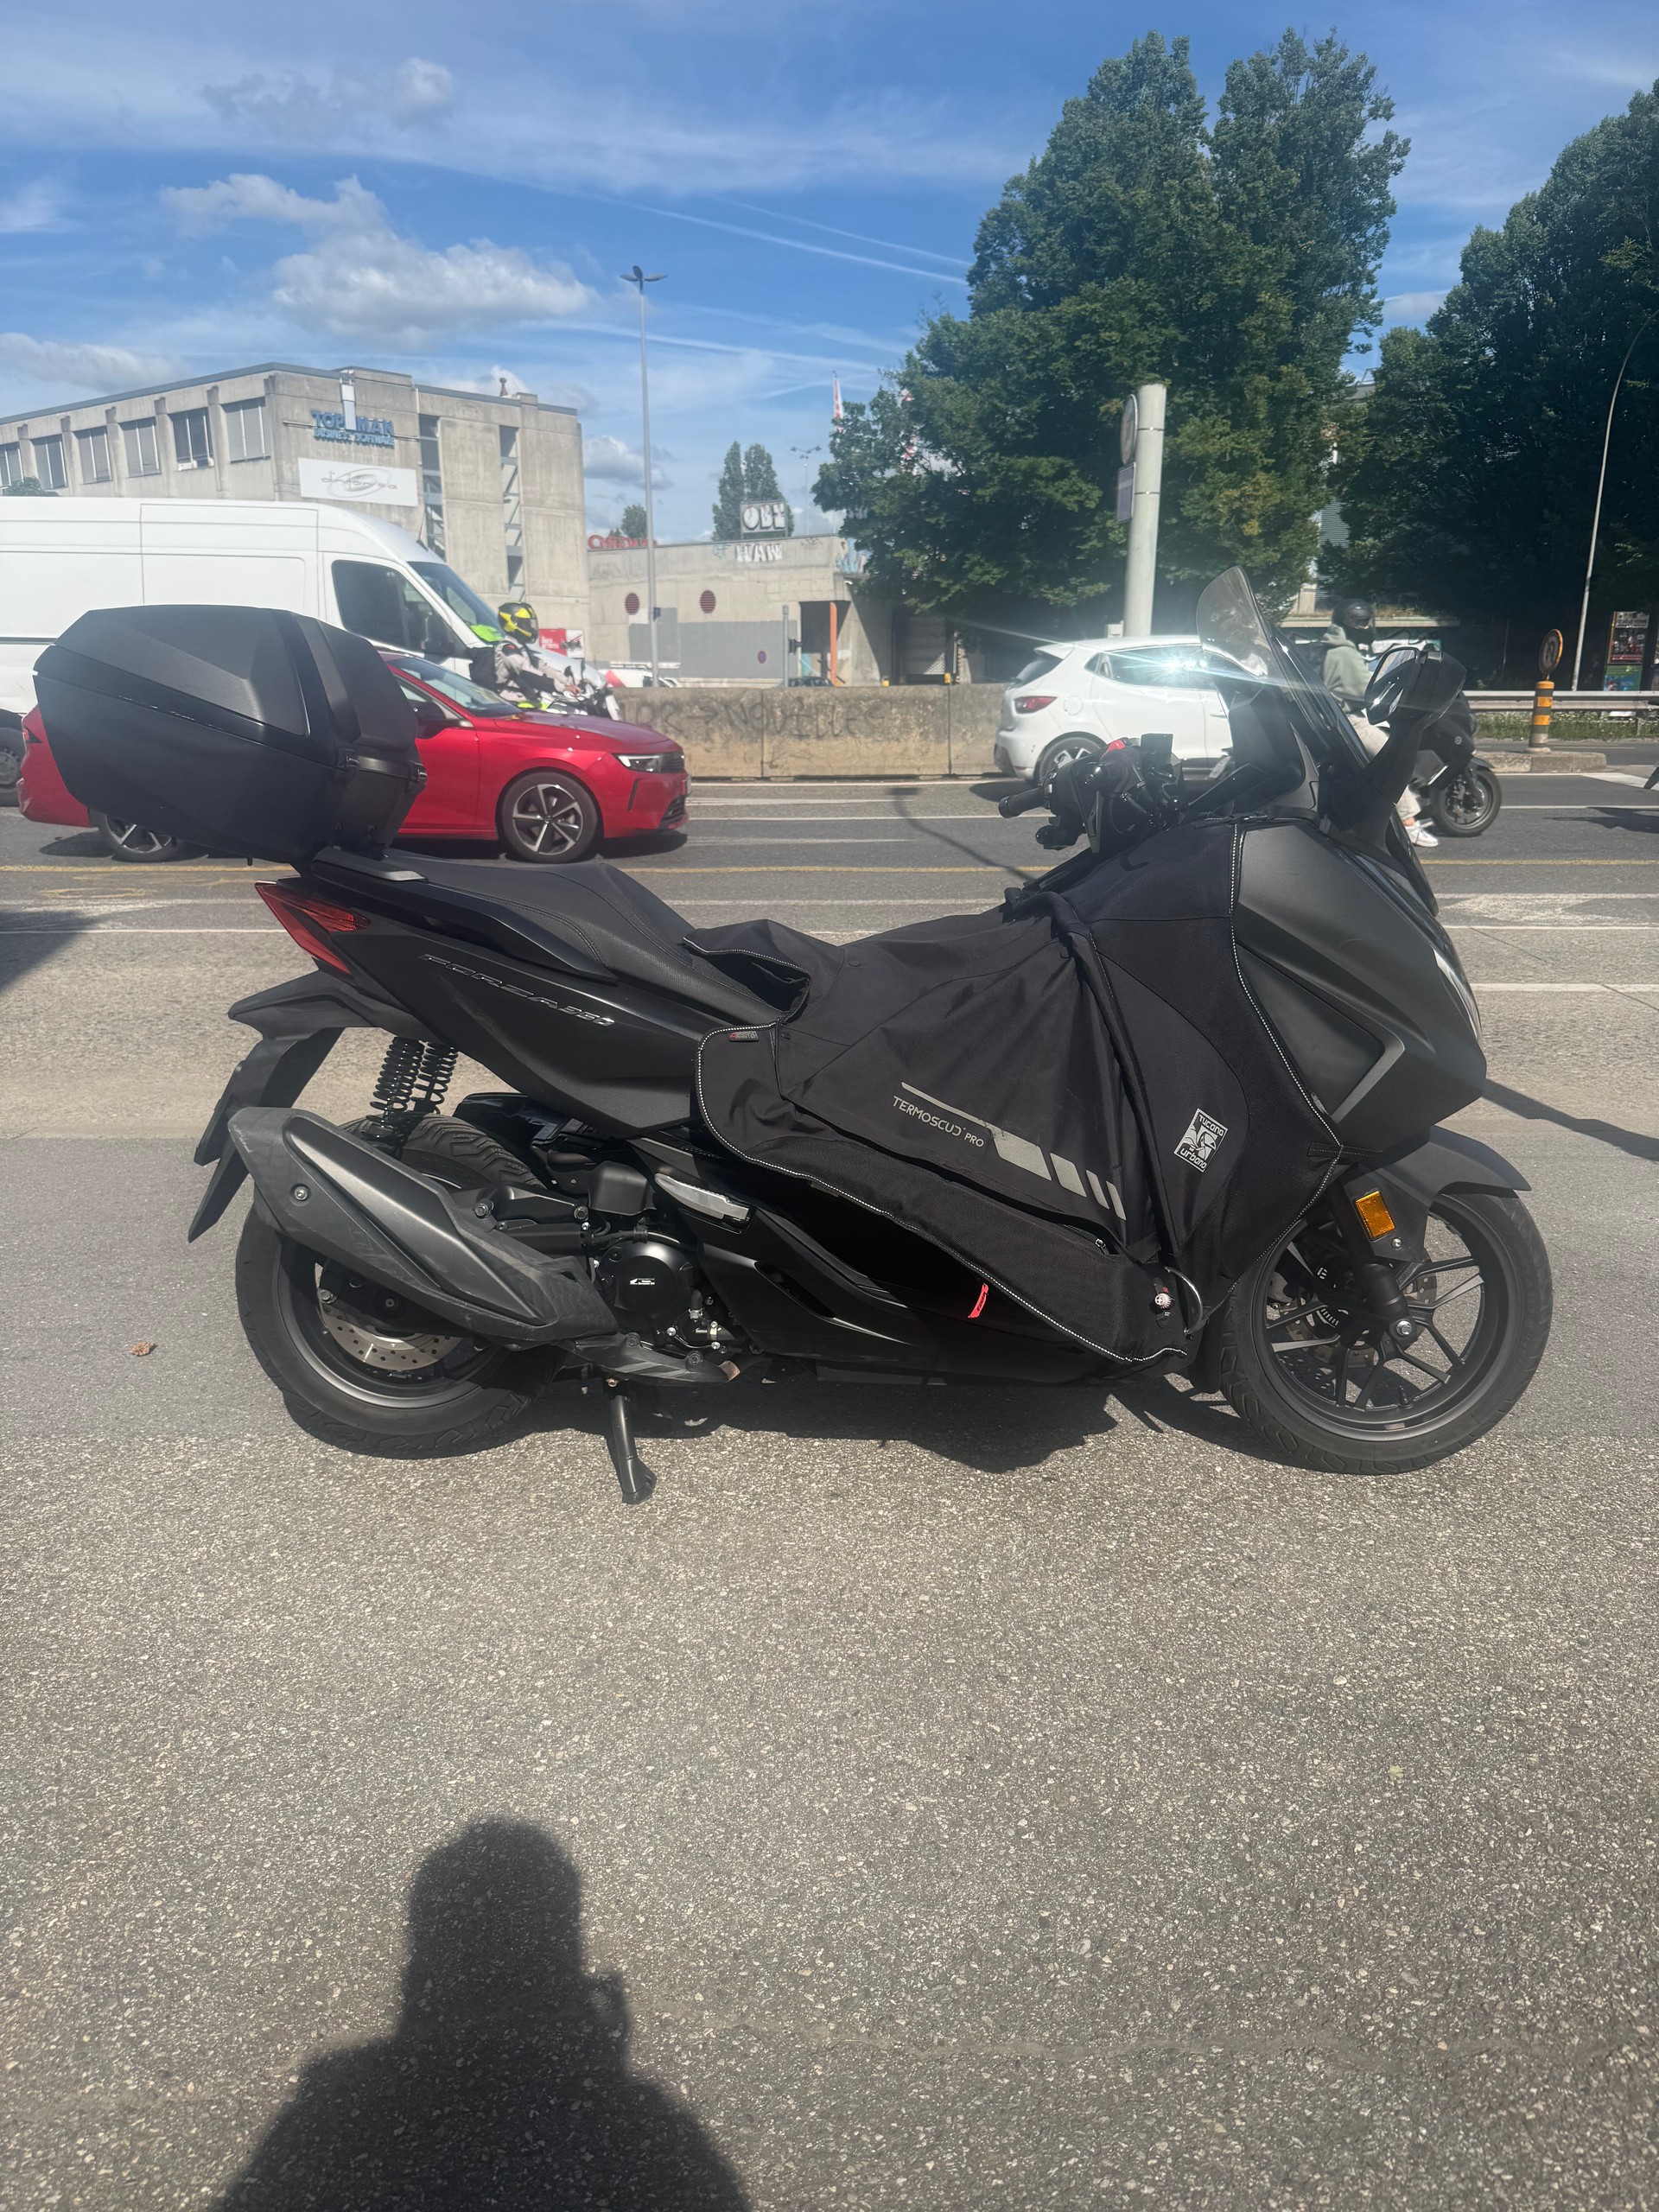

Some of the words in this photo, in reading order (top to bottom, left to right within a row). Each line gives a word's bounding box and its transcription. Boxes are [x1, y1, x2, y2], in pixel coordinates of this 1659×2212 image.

[354, 432, 396, 449] SOFTWARE
[356, 416, 395, 437] MAN
[418, 953, 558, 1009] FORZA
[893, 1095, 963, 1137] TERMOSCUD
[963, 1132, 985, 1147] PRO
